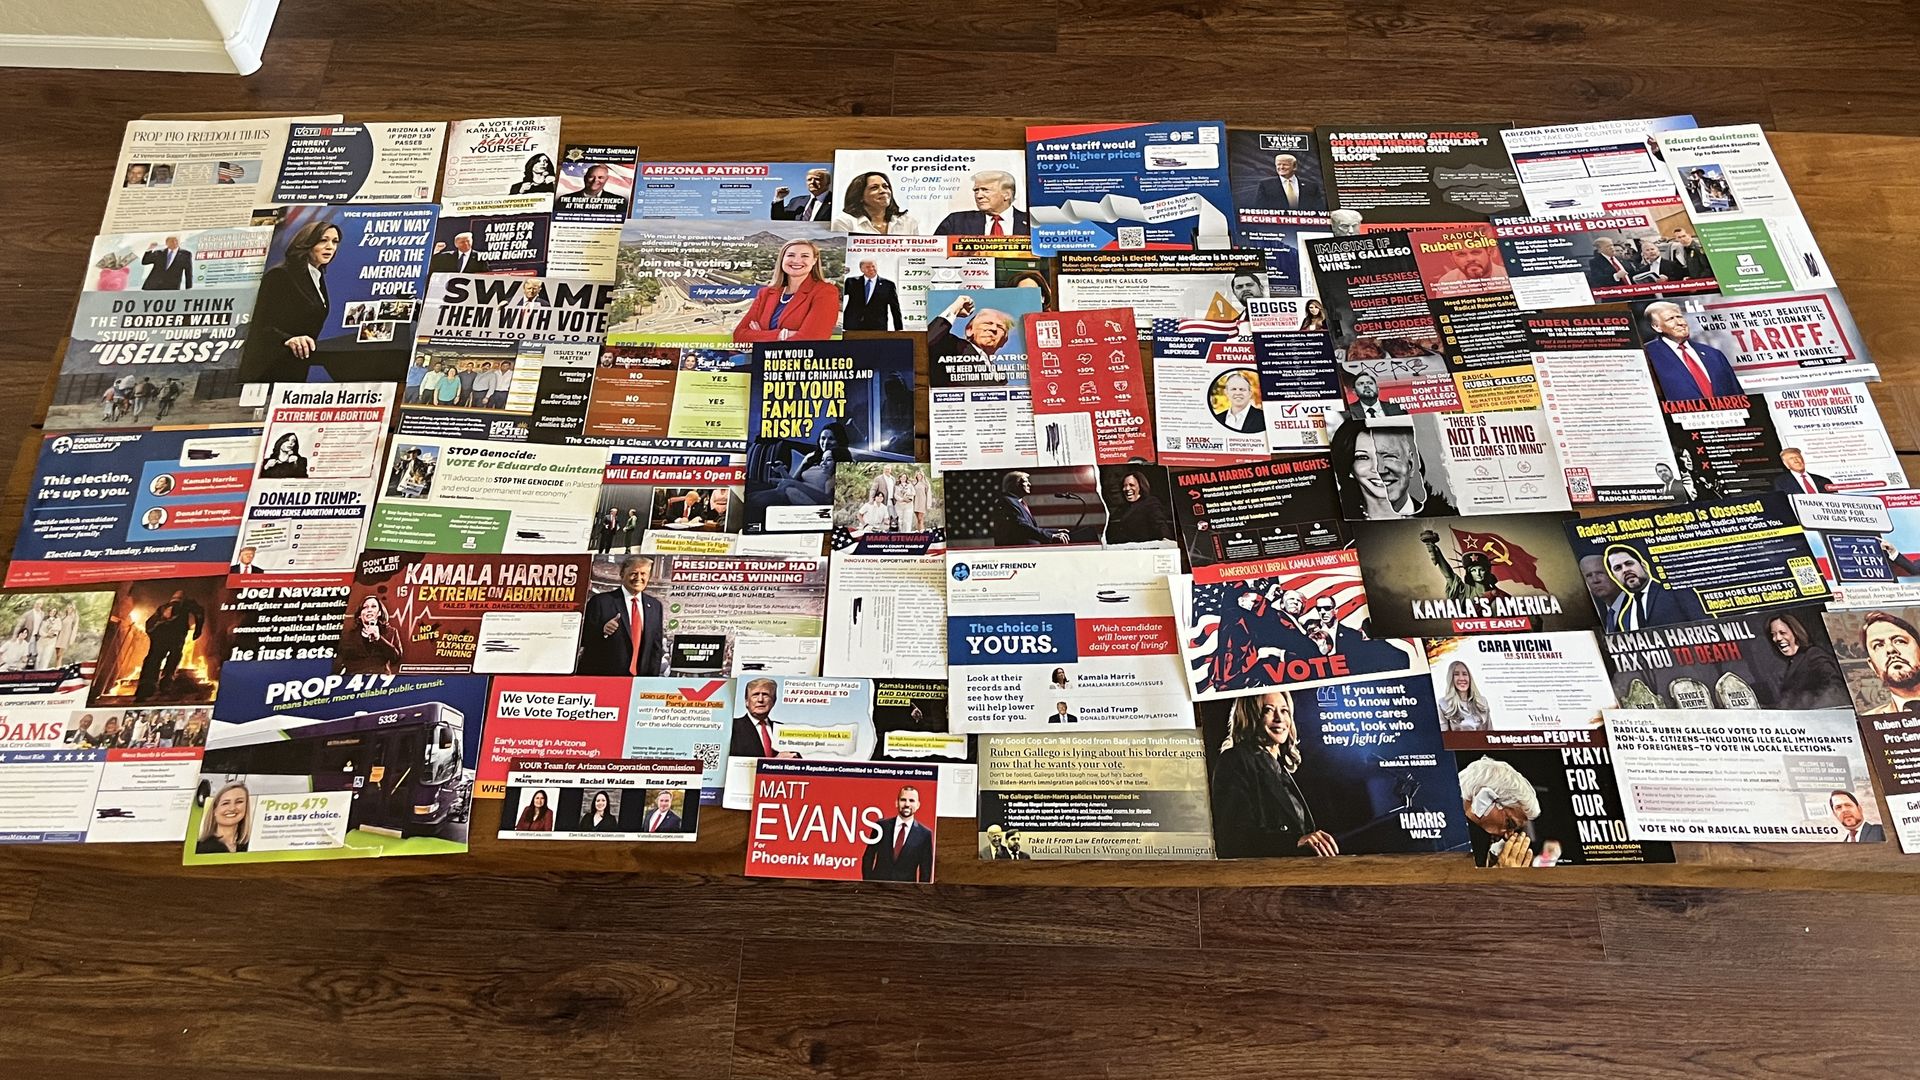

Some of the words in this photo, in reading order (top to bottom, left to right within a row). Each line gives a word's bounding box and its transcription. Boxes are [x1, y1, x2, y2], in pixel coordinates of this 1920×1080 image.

[466, 126, 507, 134] KAMALA
[511, 125, 546, 133] HARRIS
[1339, 132, 1400, 140] PRESIDENT
[1400, 132, 1428, 140] WHO
[1429, 131, 1479, 139] ATTACKS
[1665, 136, 1707, 145] Eduardo
[1709, 132, 1759, 143] Quintana:
[469, 144, 539, 153] YOURSELF
[1071, 142, 1101, 150] tariff
[1104, 141, 1136, 149] would
[645, 166, 704, 175] ARIZONA
[707, 166, 765, 175] PATRIOT:
[911, 164, 970, 173] president.
[364, 221, 373, 231] A
[377, 221, 399, 231] NEW
[402, 219, 429, 231] WAY
[358, 233, 428, 248] Forward
[477, 251, 502, 261] YOUR
[504, 249, 537, 259] RIGHTS!
[1093, 255, 1121, 263] Gallego
[1160, 254, 1177, 262] Your
[1229, 254, 1260, 263] Danger.
[1318, 252, 1356, 262] RUBEN
[1359, 248, 1411, 259] GALLEGO
[638, 258, 662, 267] Join
[683, 258, 694, 267] in
[696, 258, 732, 270] voting
[963, 269, 989, 277] 7.75%
[112, 300, 135, 313] DO
[140, 300, 176, 312] YOU
[184, 298, 233, 311] THINK
[1351, 298, 1388, 308] HIGHER
[1391, 294, 1426, 304] PRICES
[1251, 302, 1297, 314] BOGGS
[1702, 320, 1727, 331] WORD
[1730, 319, 1739, 328] IN
[1742, 318, 1761, 327] THE
[1763, 314, 1812, 325] DICTIONARY
[1731, 324, 1834, 350] TARIFF.
[615, 356, 641, 364] Ruben
[643, 358, 672, 367] Gallego
[763, 383, 794, 399] PUT
[799, 382, 844, 398] YOUR
[1782, 391, 1799, 399] ONLY
[1802, 389, 1828, 398] TRUMP
[1831, 388, 1850, 396] WILL
[762, 402, 822, 418] FAMILY
[826, 401, 846, 417] AT
[762, 420, 813, 438] RISK?
[1447, 430, 1475, 444] NOT
[1479, 429, 1491, 442] A
[1494, 428, 1534, 442] THING
[448, 447, 477, 456] STOP
[481, 449, 536, 460] Genocide:
[1178, 471, 1215, 486] KAMALA
[1217, 468, 1253, 482] HARRIS
[1256, 466, 1268, 478] ON
[1270, 463, 1293, 476] GUN
[1295, 459, 1330, 473] RIGHTS:
[43, 476, 72, 486] This
[77, 473, 132, 486] election,
[259, 492, 310, 505] DONALD
[314, 492, 361, 505] TRUMP:
[44, 550, 81, 559] Election
[82, 549, 103, 558] Day:
[104, 547, 142, 556] Tuesday,
[143, 545, 189, 553] November
[190, 544, 197, 552] 5
[1852, 544, 1876, 554] 2.11
[1854, 556, 1884, 567] VERY
[405, 563, 492, 585] KAMALA
[498, 564, 578, 586] HARRIS
[1859, 568, 1884, 578] LOW
[1411, 597, 1493, 620] KAMALA'S
[1495, 594, 1563, 617] AMERICA
[1456, 620, 1487, 630] VOTE
[1489, 618, 1527, 629] EARLY
[1605, 632, 1663, 652] KAMALA
[1668, 627, 1719, 647] HARRIS
[1722, 622, 1755, 640] WILL
[967, 636, 1058, 654] YOURS.
[230, 649, 255, 661] he
[259, 646, 293, 662] just
[297, 646, 337, 659] acts.
[1611, 653, 1640, 672] TAX
[1645, 649, 1672, 668] YOU
[1674, 650, 1694, 664] TO
[1696, 645, 1742, 662] DEATH
[1263, 655, 1349, 683] VOTE
[265, 677, 341, 703] PROP
[1342, 686, 1350, 694] If
[1353, 687, 1373, 697] you
[1377, 684, 1405, 693] want
[378, 714, 398, 725] 5332
[501, 708, 522, 716] We
[527, 708, 553, 717] Vote
[557, 708, 615, 721] Together.
[1544, 731, 1591, 743] PEOPLE
[519, 762, 542, 770] YOUR
[545, 762, 563, 770] Team
[578, 763, 605, 771] Arizona
[608, 764, 649, 772] Corporation
[652, 764, 695, 772] Commission
[759, 780, 810, 799] MATT
[1571, 796, 1604, 817] OUR
[288, 813, 308, 822] easy
[310, 811, 341, 820] choice.
[1400, 813, 1446, 828] HARRIS
[755, 802, 884, 845] EVANS
[1640, 825, 1666, 834] VOTE
[1671, 825, 1685, 833] NO
[1689, 825, 1704, 833] ON
[1708, 826, 1751, 835] RADICAL
[1753, 827, 1788, 835] RUBEN
[1791, 827, 1838, 835] GALLEGO
[1091, 837, 1141, 845] Enforcement:
[1410, 830, 1441, 839] WALZ
[751, 850, 810, 865] Phoenix
[813, 852, 858, 870] Mayor
